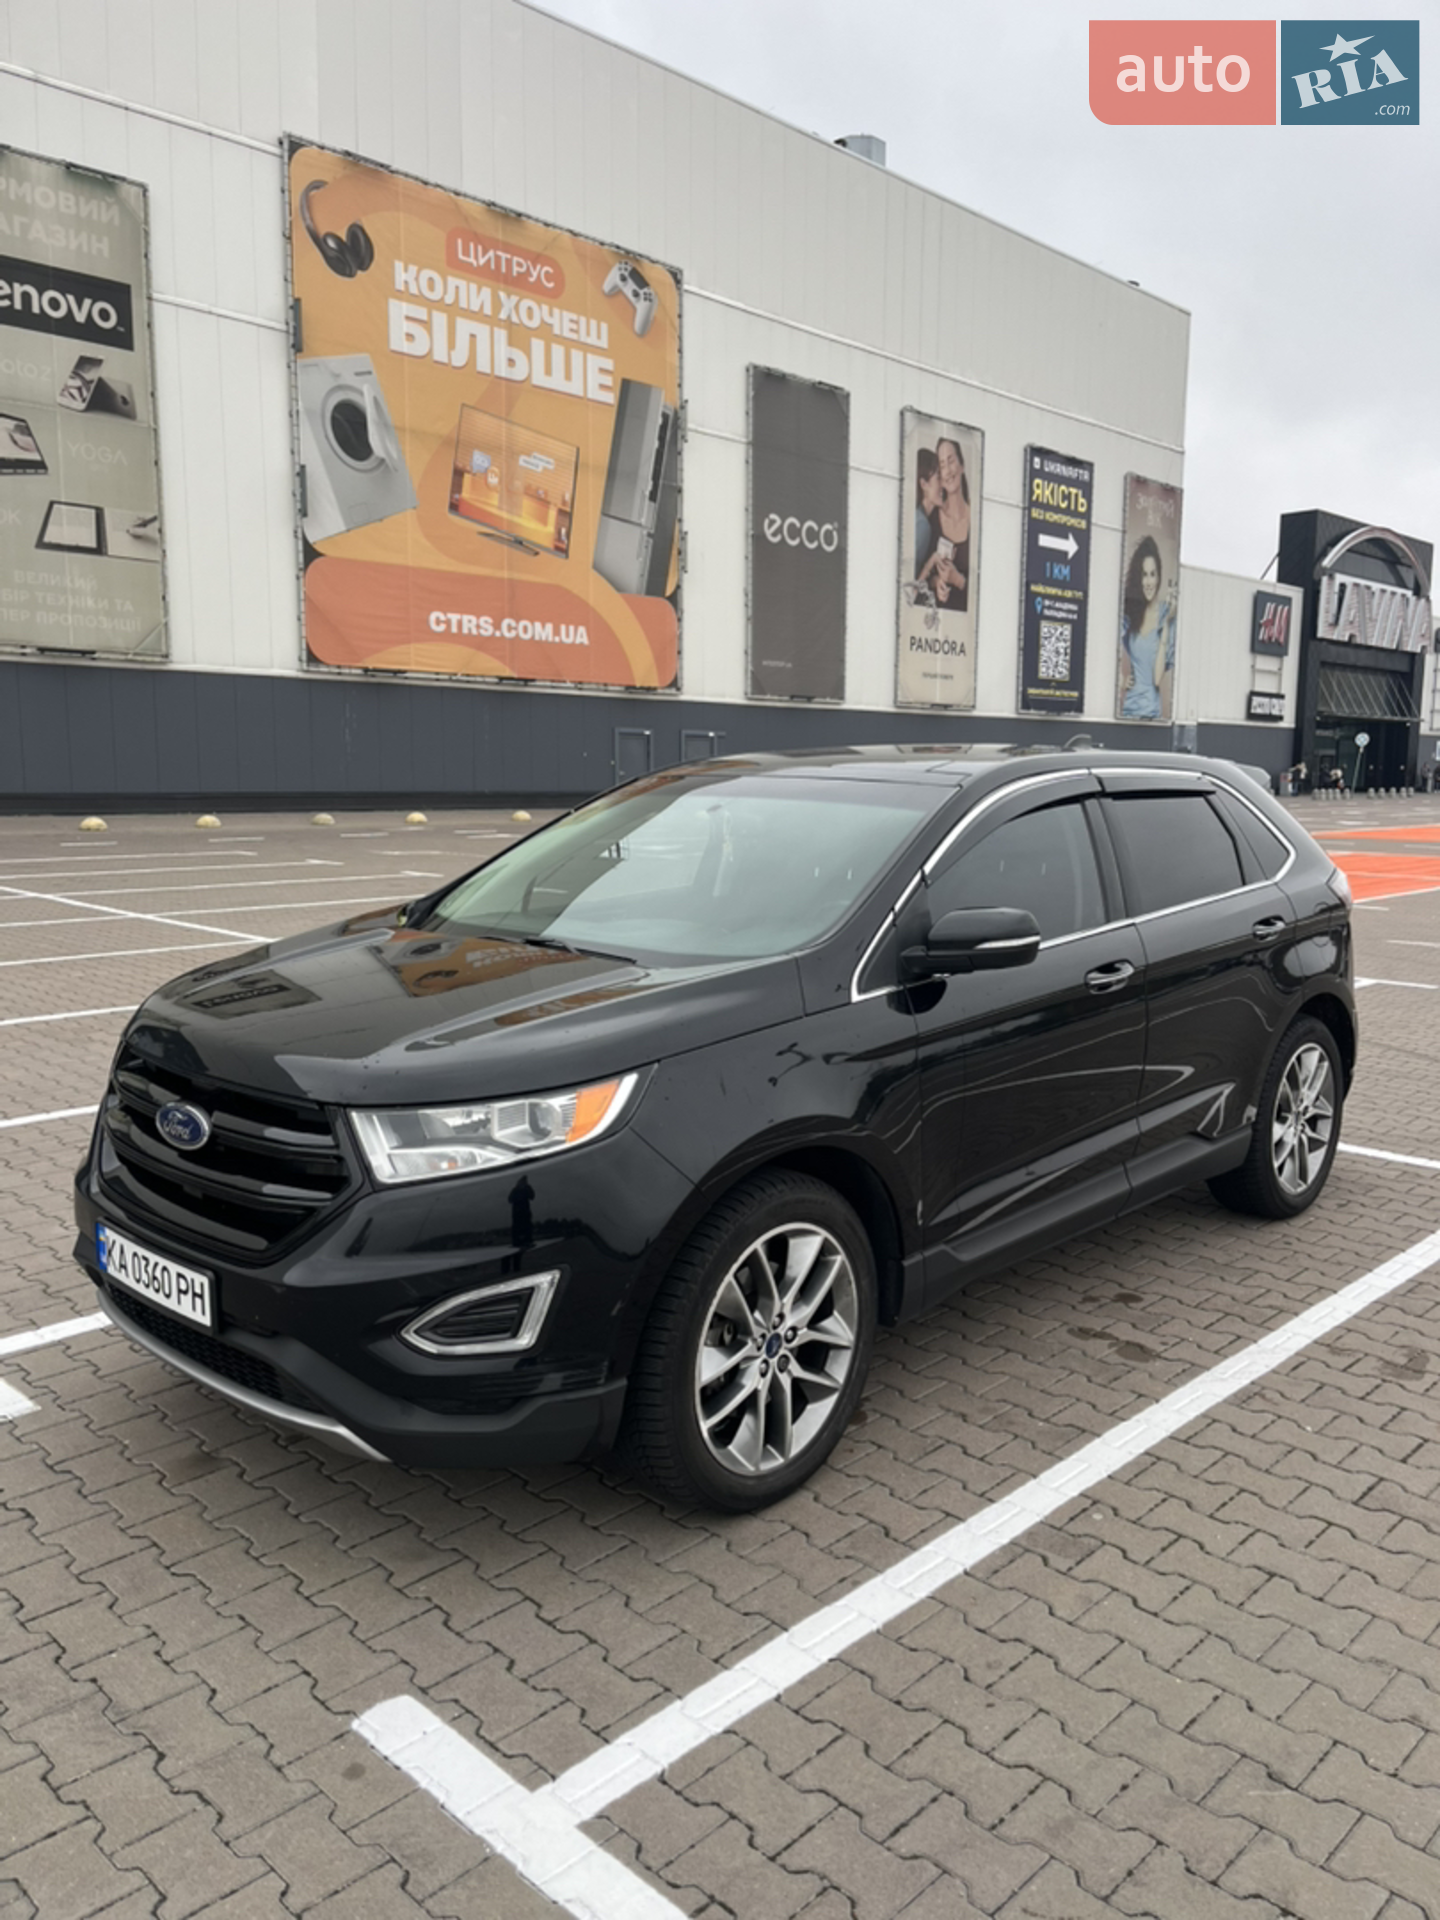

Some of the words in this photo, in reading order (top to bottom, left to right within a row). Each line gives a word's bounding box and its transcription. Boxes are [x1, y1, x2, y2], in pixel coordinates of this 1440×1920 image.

[456, 237, 555, 289] ЦИТРУС
[394, 259, 493, 317] КОЛИ
[497, 291, 609, 350] ХОЧЕШ
[388, 298, 615, 405] БІЛЬШЕ
[1031, 477, 1088, 513] ЯКІСТЬ
[763, 512, 839, 553] ecco
[114, 598, 135, 613] ТА
[1317, 573, 1432, 654] LAVINA
[428, 610, 590, 646] CTRS.COM.UA
[909, 634, 967, 657] PANDORA
[163, 1110, 194, 1141] Ford
[107, 1236, 129, 1278] KA
[131, 1251, 172, 1300] 0360
[175, 1271, 206, 1317] PH
